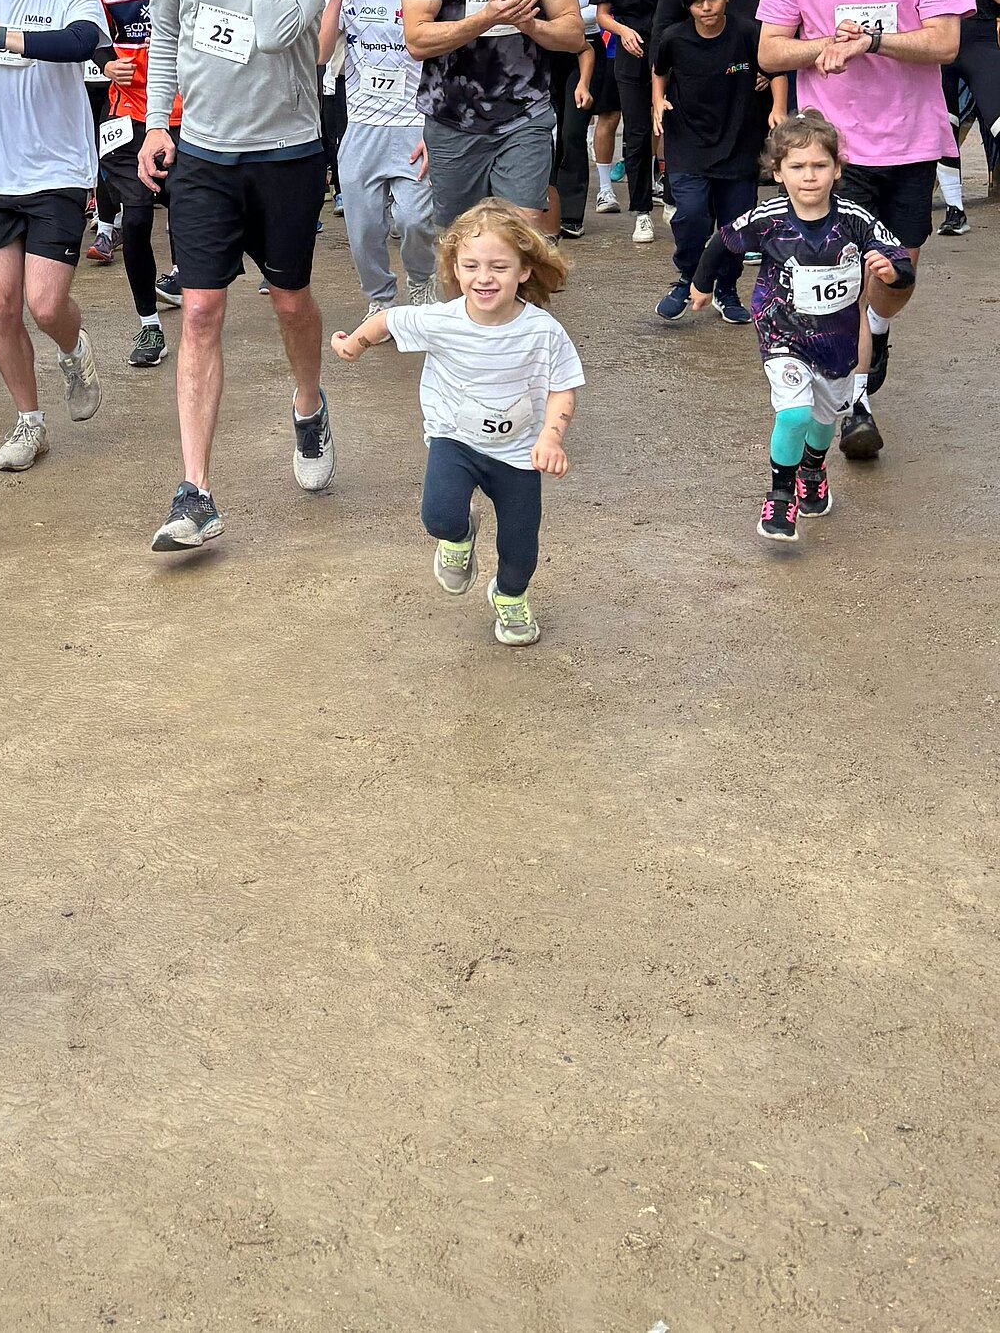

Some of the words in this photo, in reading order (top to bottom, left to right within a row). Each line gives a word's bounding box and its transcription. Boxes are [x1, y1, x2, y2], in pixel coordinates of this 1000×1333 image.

[210, 25, 234, 44] 25
[371, 76, 395, 90] 177
[102, 128, 123, 145] 169
[811, 280, 848, 302] 165
[482, 419, 513, 434] 50
